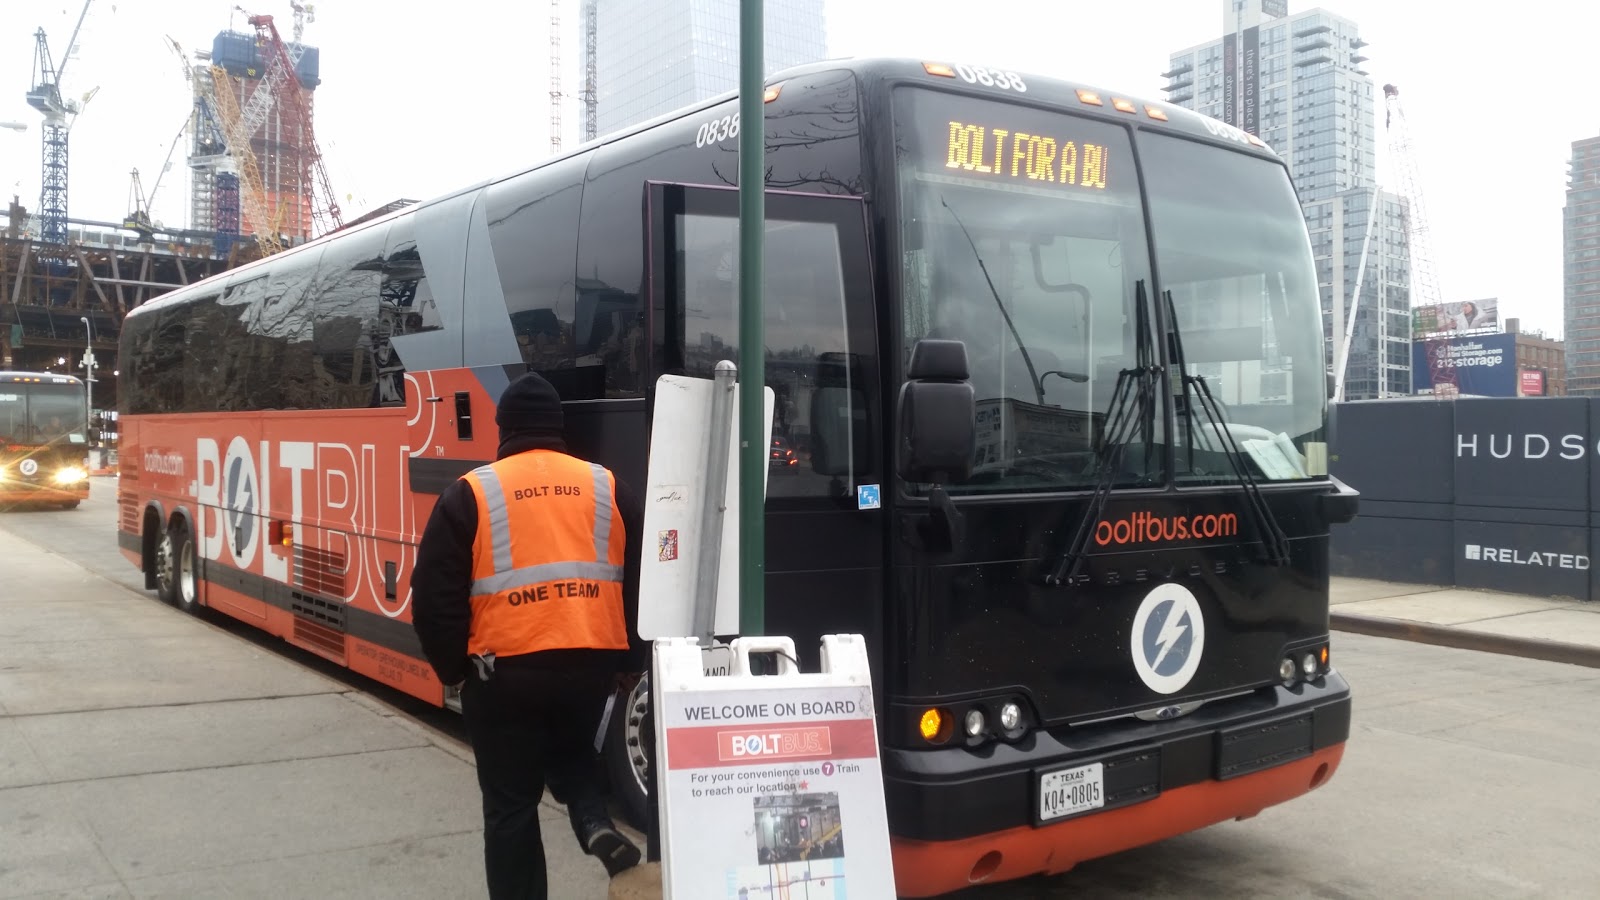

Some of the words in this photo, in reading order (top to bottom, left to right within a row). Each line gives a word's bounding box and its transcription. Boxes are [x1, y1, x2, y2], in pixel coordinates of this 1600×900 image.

[1246, 49, 1255, 80] there's
[955, 65, 1027, 93] 0838
[1246, 83, 1254, 96] no
[1245, 98, 1256, 124] place
[696, 112, 740, 149] 0838
[946, 121, 1009, 174] BOLT
[1011, 132, 1057, 182] FOR
[1060, 141, 1077, 185] A
[1457, 434, 1600, 460] HUDS
[514, 486, 549, 501] BOLT
[554, 485, 581, 496] BUS
[1483, 547, 1590, 570] RELATED
[508, 586, 549, 606] ONE
[554, 582, 600, 599] TEAM
[684, 705, 769, 721] WELCOME
[773, 703, 796, 717] ON
[801, 701, 856, 716] BOARD
[691, 773, 708, 783] For
[711, 773, 735, 784] your
[737, 767, 800, 780] convenience
[803, 767, 820, 776] use
[836, 764, 860, 774] Train
[1060, 770, 1085, 783] TEXAS
[692, 788, 703, 798] to
[705, 784, 734, 796] reach
[736, 785, 754, 795] our
[756, 781, 797, 793] location
